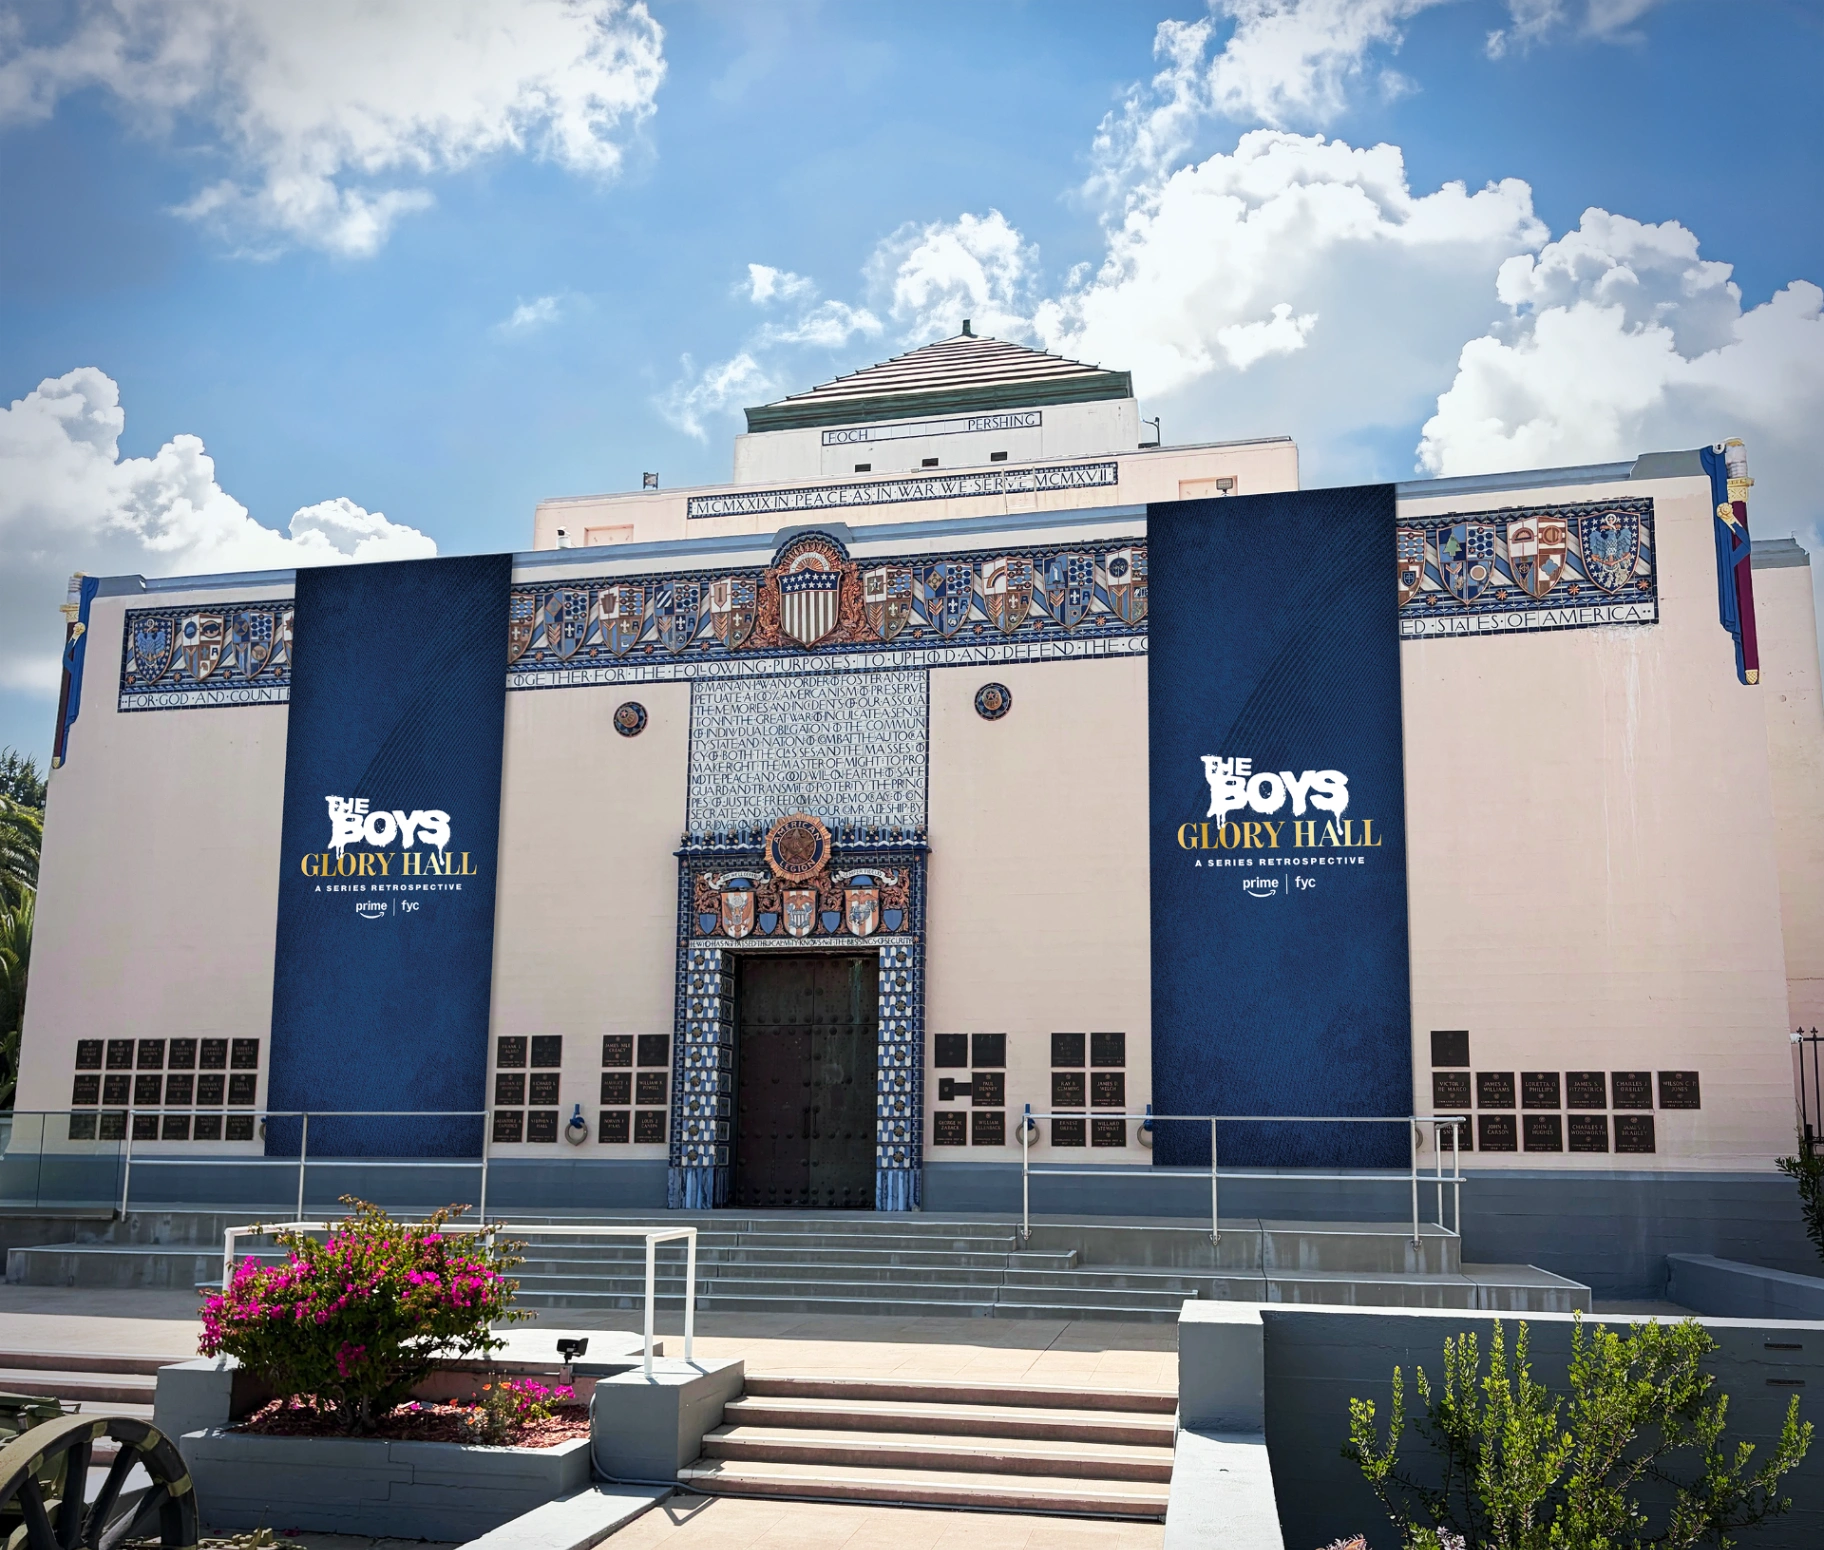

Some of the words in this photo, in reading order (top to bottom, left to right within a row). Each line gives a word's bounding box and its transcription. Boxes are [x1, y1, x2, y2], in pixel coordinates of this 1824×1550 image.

[828, 429, 869, 443] FOCH
[967, 413, 1035, 431] PERSHING
[696, 497, 770, 514] MCMXXIX
[774, 495, 789, 508] IN
[795, 490, 848, 505] PEACE
[852, 488, 871, 501] AS
[877, 486, 892, 500] IN
[898, 484, 935, 498] WAR
[941, 481, 968, 495] WE
[1035, 469, 1107, 486] MCMXVII
[1437, 614, 1499, 632] STATES
[1507, 611, 1537, 627] OF
[1542, 605, 1640, 625] AMERICA
[593, 668, 626, 682] FOR
[630, 667, 666, 679] THE
[772, 655, 851, 671] PURPOSES
[856, 653, 885, 667] TO
[960, 646, 995, 661] AND
[1002, 641, 1075, 659] DEFEND
[1079, 639, 1119, 653] THE
[769, 677, 791, 689] AND
[793, 675, 829, 688] ORDER
[841, 673, 882, 685] FOSTER
[883, 671, 905, 683] AND
[906, 670, 925, 682] PER
[128, 695, 156, 707] FOR
[158, 693, 189, 705] GOD
[194, 691, 225, 704] AND
[694, 692, 741, 705] PETUATE
[870, 682, 925, 696] PRESERVE
[696, 705, 714, 716] THE
[769, 701, 790, 712] AND
[858, 696, 881, 708] OUR
[734, 714, 753, 725] THE
[755, 712, 787, 724] GREAT
[788, 711, 811, 723] WAR
[890, 706, 925, 718] SENSE
[843, 721, 862, 732] THE
[722, 748, 752, 760] BOTH
[755, 747, 774, 759] THE
[816, 744, 841, 756] AND
[864, 741, 910, 754] MASSES
[737, 737, 759, 748] AND
[760, 759, 779, 771] THE
[780, 757, 825, 770] MASTER
[845, 755, 879, 767] MIGHT
[902, 753, 925, 764] PRO
[1200, 754, 1252, 776] THE
[721, 772, 754, 784] PEACE
[752, 771, 775, 782] AND
[845, 766, 882, 779] EARTH
[896, 765, 924, 777] SAFE
[691, 784, 728, 797] GUARD
[728, 783, 751, 795] AND
[869, 778, 891, 789] THE
[1206, 770, 1349, 819] BOYS
[325, 795, 370, 814] THE
[811, 792, 833, 804] AND
[690, 807, 737, 820] SECRATE
[738, 806, 761, 818] AND
[817, 804, 840, 815] OUR
[327, 809, 451, 851] BOYS
[773, 821, 822, 844] AMERICAN
[1177, 821, 1286, 850] GLORY
[1293, 819, 1382, 847] HALL
[301, 853, 395, 877] GLORY
[401, 851, 478, 876] HALL
[780, 859, 816, 872] LEGION
[1208, 858, 1253, 867] SERIES
[1259, 857, 1365, 866] RETROSPECTIVE
[326, 884, 366, 892] SERIES
[371, 883, 462, 891] RETROSPECTIVE
[1242, 877, 1279, 891] prime
[1295, 876, 1316, 891] fyc
[355, 900, 388, 913] prime
[401, 899, 419, 913] fyc
